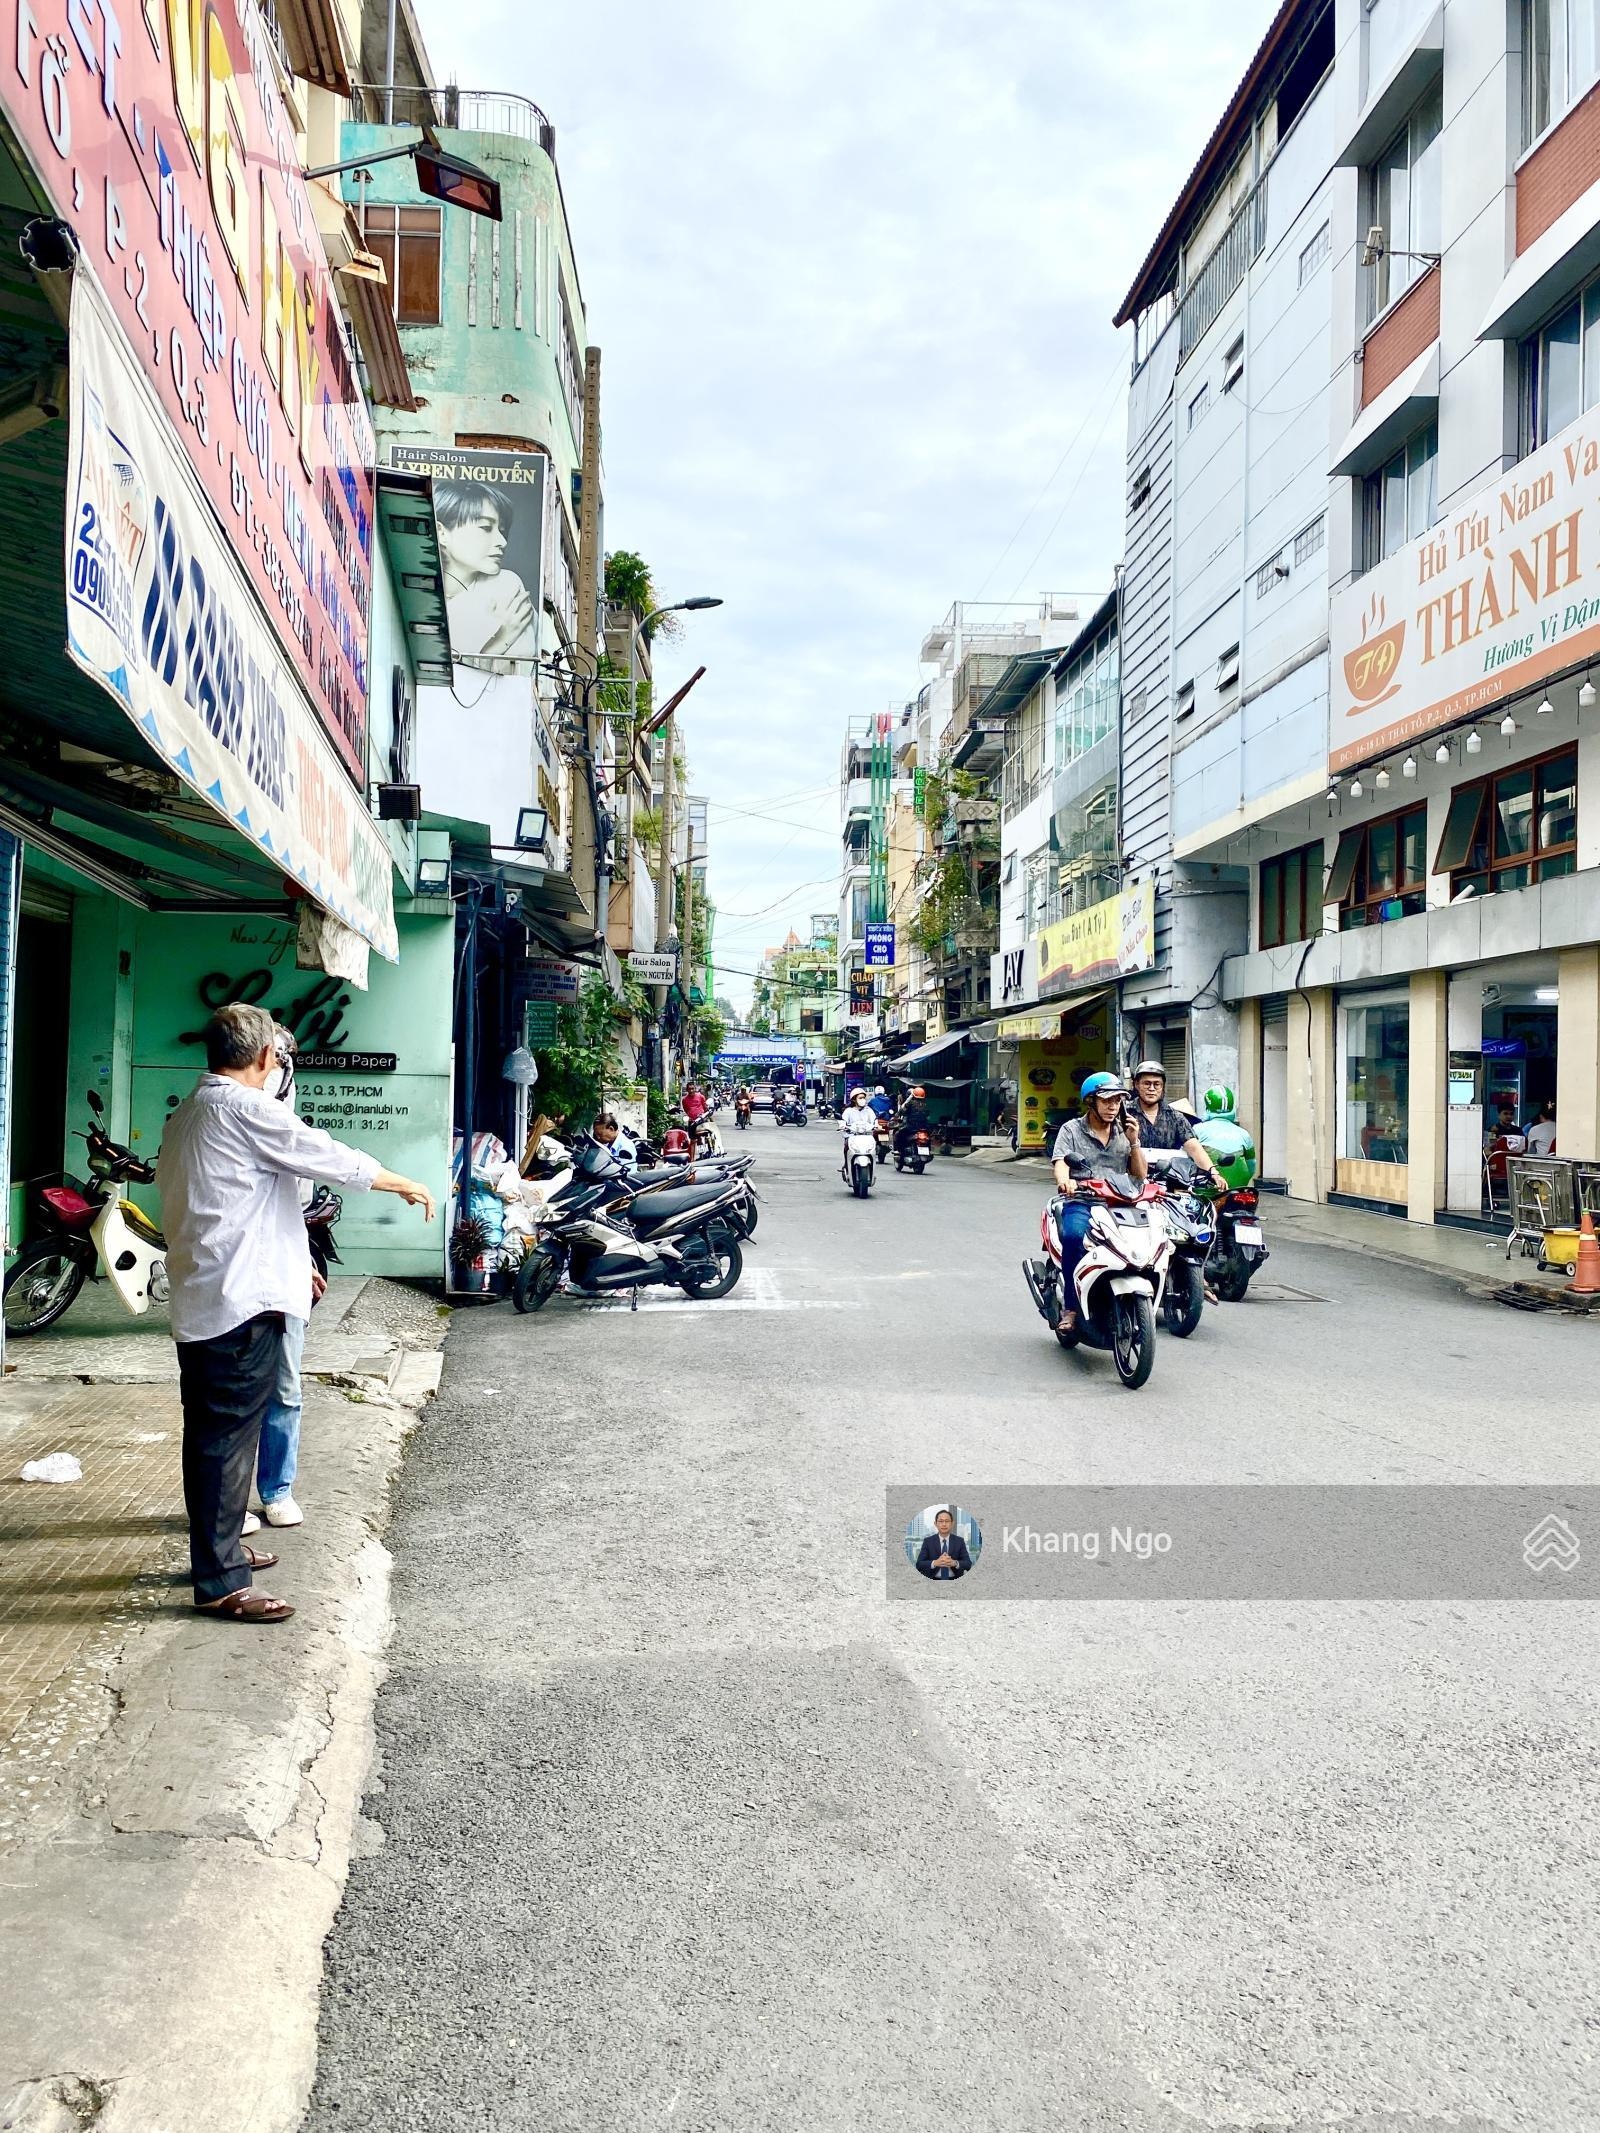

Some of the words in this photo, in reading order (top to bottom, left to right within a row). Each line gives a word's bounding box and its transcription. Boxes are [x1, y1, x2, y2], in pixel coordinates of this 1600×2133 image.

[154, 111, 226, 373] THIỆP
[232, 337, 273, 498] CƯỚI
[282, 465, 315, 597] MENU
[396, 449, 427, 460] Hair
[430, 451, 466, 463] Salon
[460, 460, 536, 485] NGUYỄN
[171, 327, 207, 446] Q.3
[262, 524, 313, 668] 38391781
[1418, 529, 1447, 586] Hủ
[1455, 509, 1490, 562] Tíu
[1499, 470, 1554, 534] Nam
[1417, 508, 1584, 666] THÀNH
[1483, 633, 1533, 673] Hương
[1540, 617, 1558, 643] Vị
[1388, 723, 1408, 742] THÁI
[1464, 679, 1502, 705] TP.HCM
[230, 924, 257, 945] New
[873, 944, 888, 953] CHO
[632, 957, 648, 965] Hair
[650, 958, 671, 966] Salon
[1002, 949, 1025, 999] JAY
[296, 1053, 346, 1068] edding
[351, 1054, 393, 1069] Paper
[339, 1086, 383, 1097] TP.HCM
